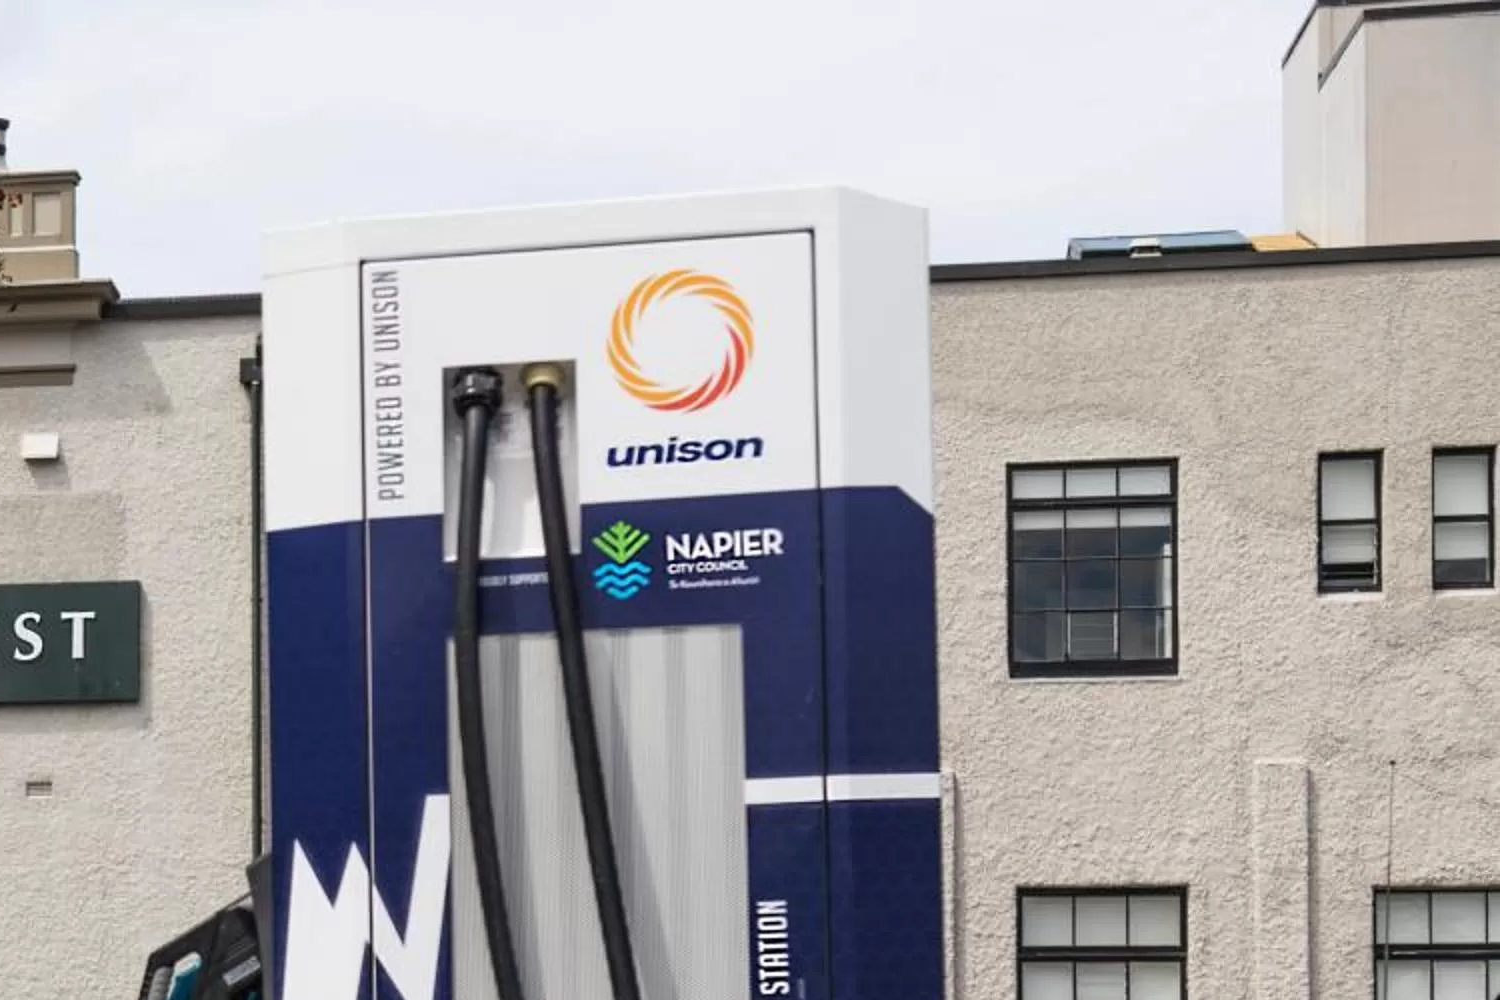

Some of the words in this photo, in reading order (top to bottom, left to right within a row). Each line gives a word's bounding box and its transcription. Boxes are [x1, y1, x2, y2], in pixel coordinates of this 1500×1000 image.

[371, 270, 401, 352] UNISON
[374, 361, 402, 387] BY
[375, 396, 405, 501] POWERED
[607, 436, 764, 468] unison
[665, 528, 784, 560] NAPIER
[667, 563, 695, 575] CITY
[696, 560, 749, 573] COUNCIL
[757, 900, 790, 995] STATION
